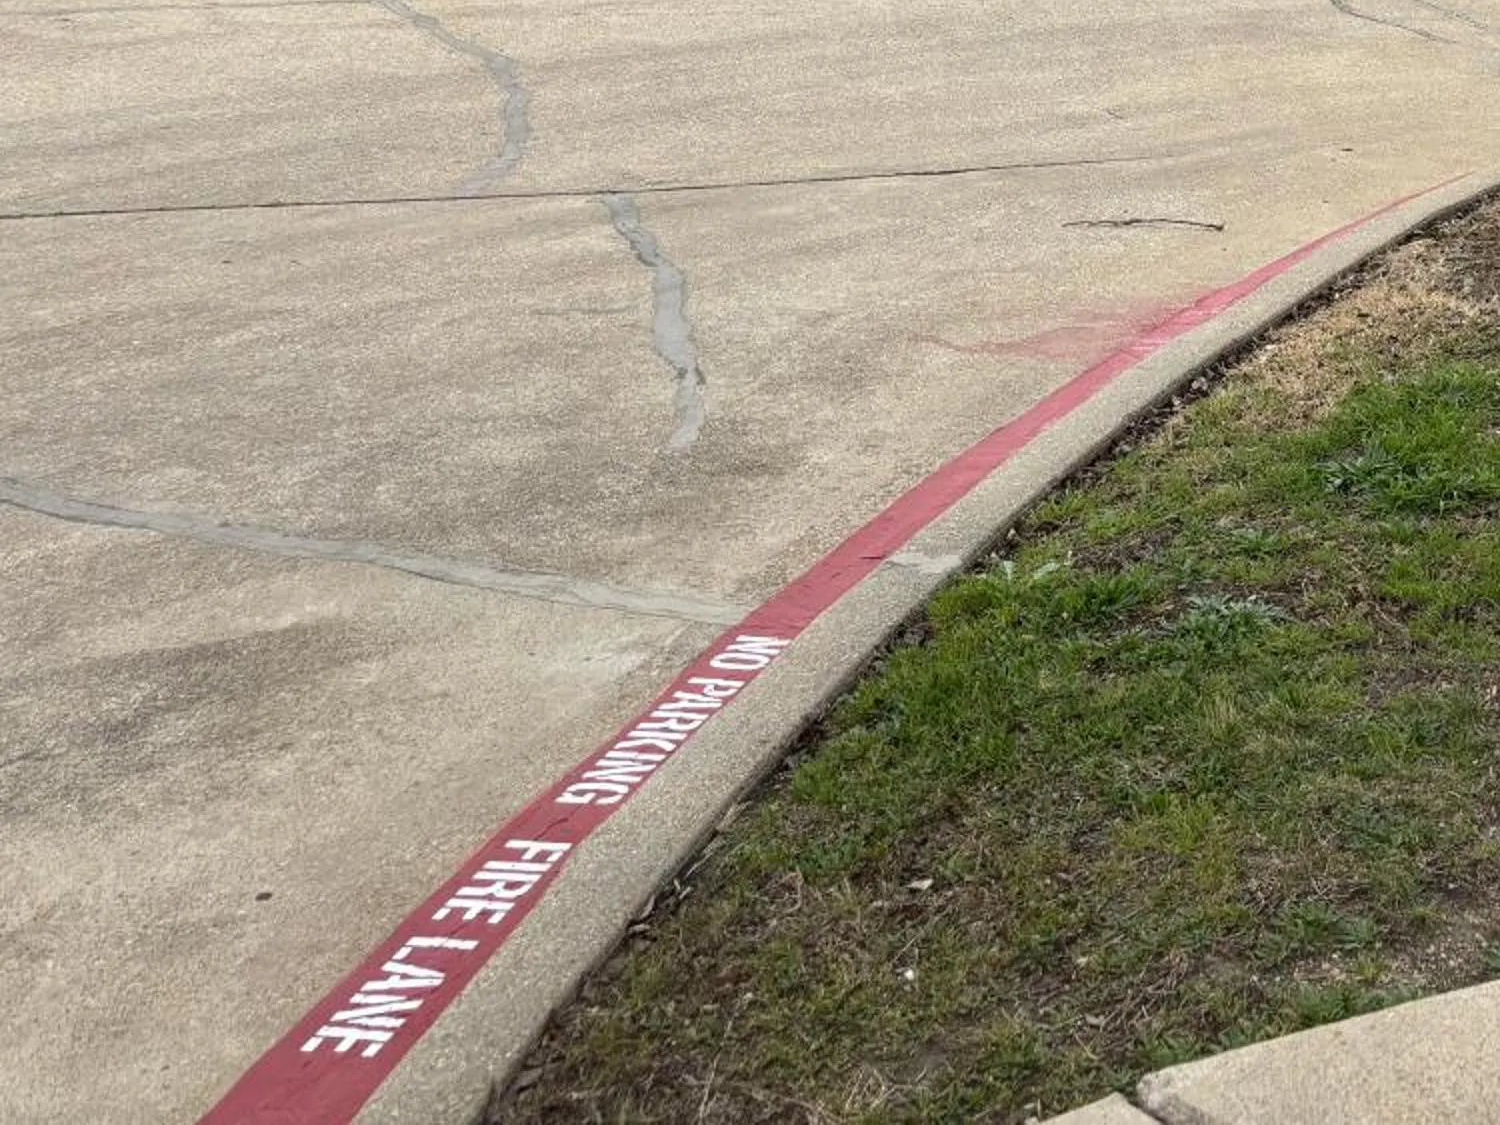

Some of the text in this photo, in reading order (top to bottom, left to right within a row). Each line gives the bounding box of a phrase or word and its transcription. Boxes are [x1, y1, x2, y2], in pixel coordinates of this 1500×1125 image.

[300, 634, 791, 1058] NO PARKING FIRE LANE
